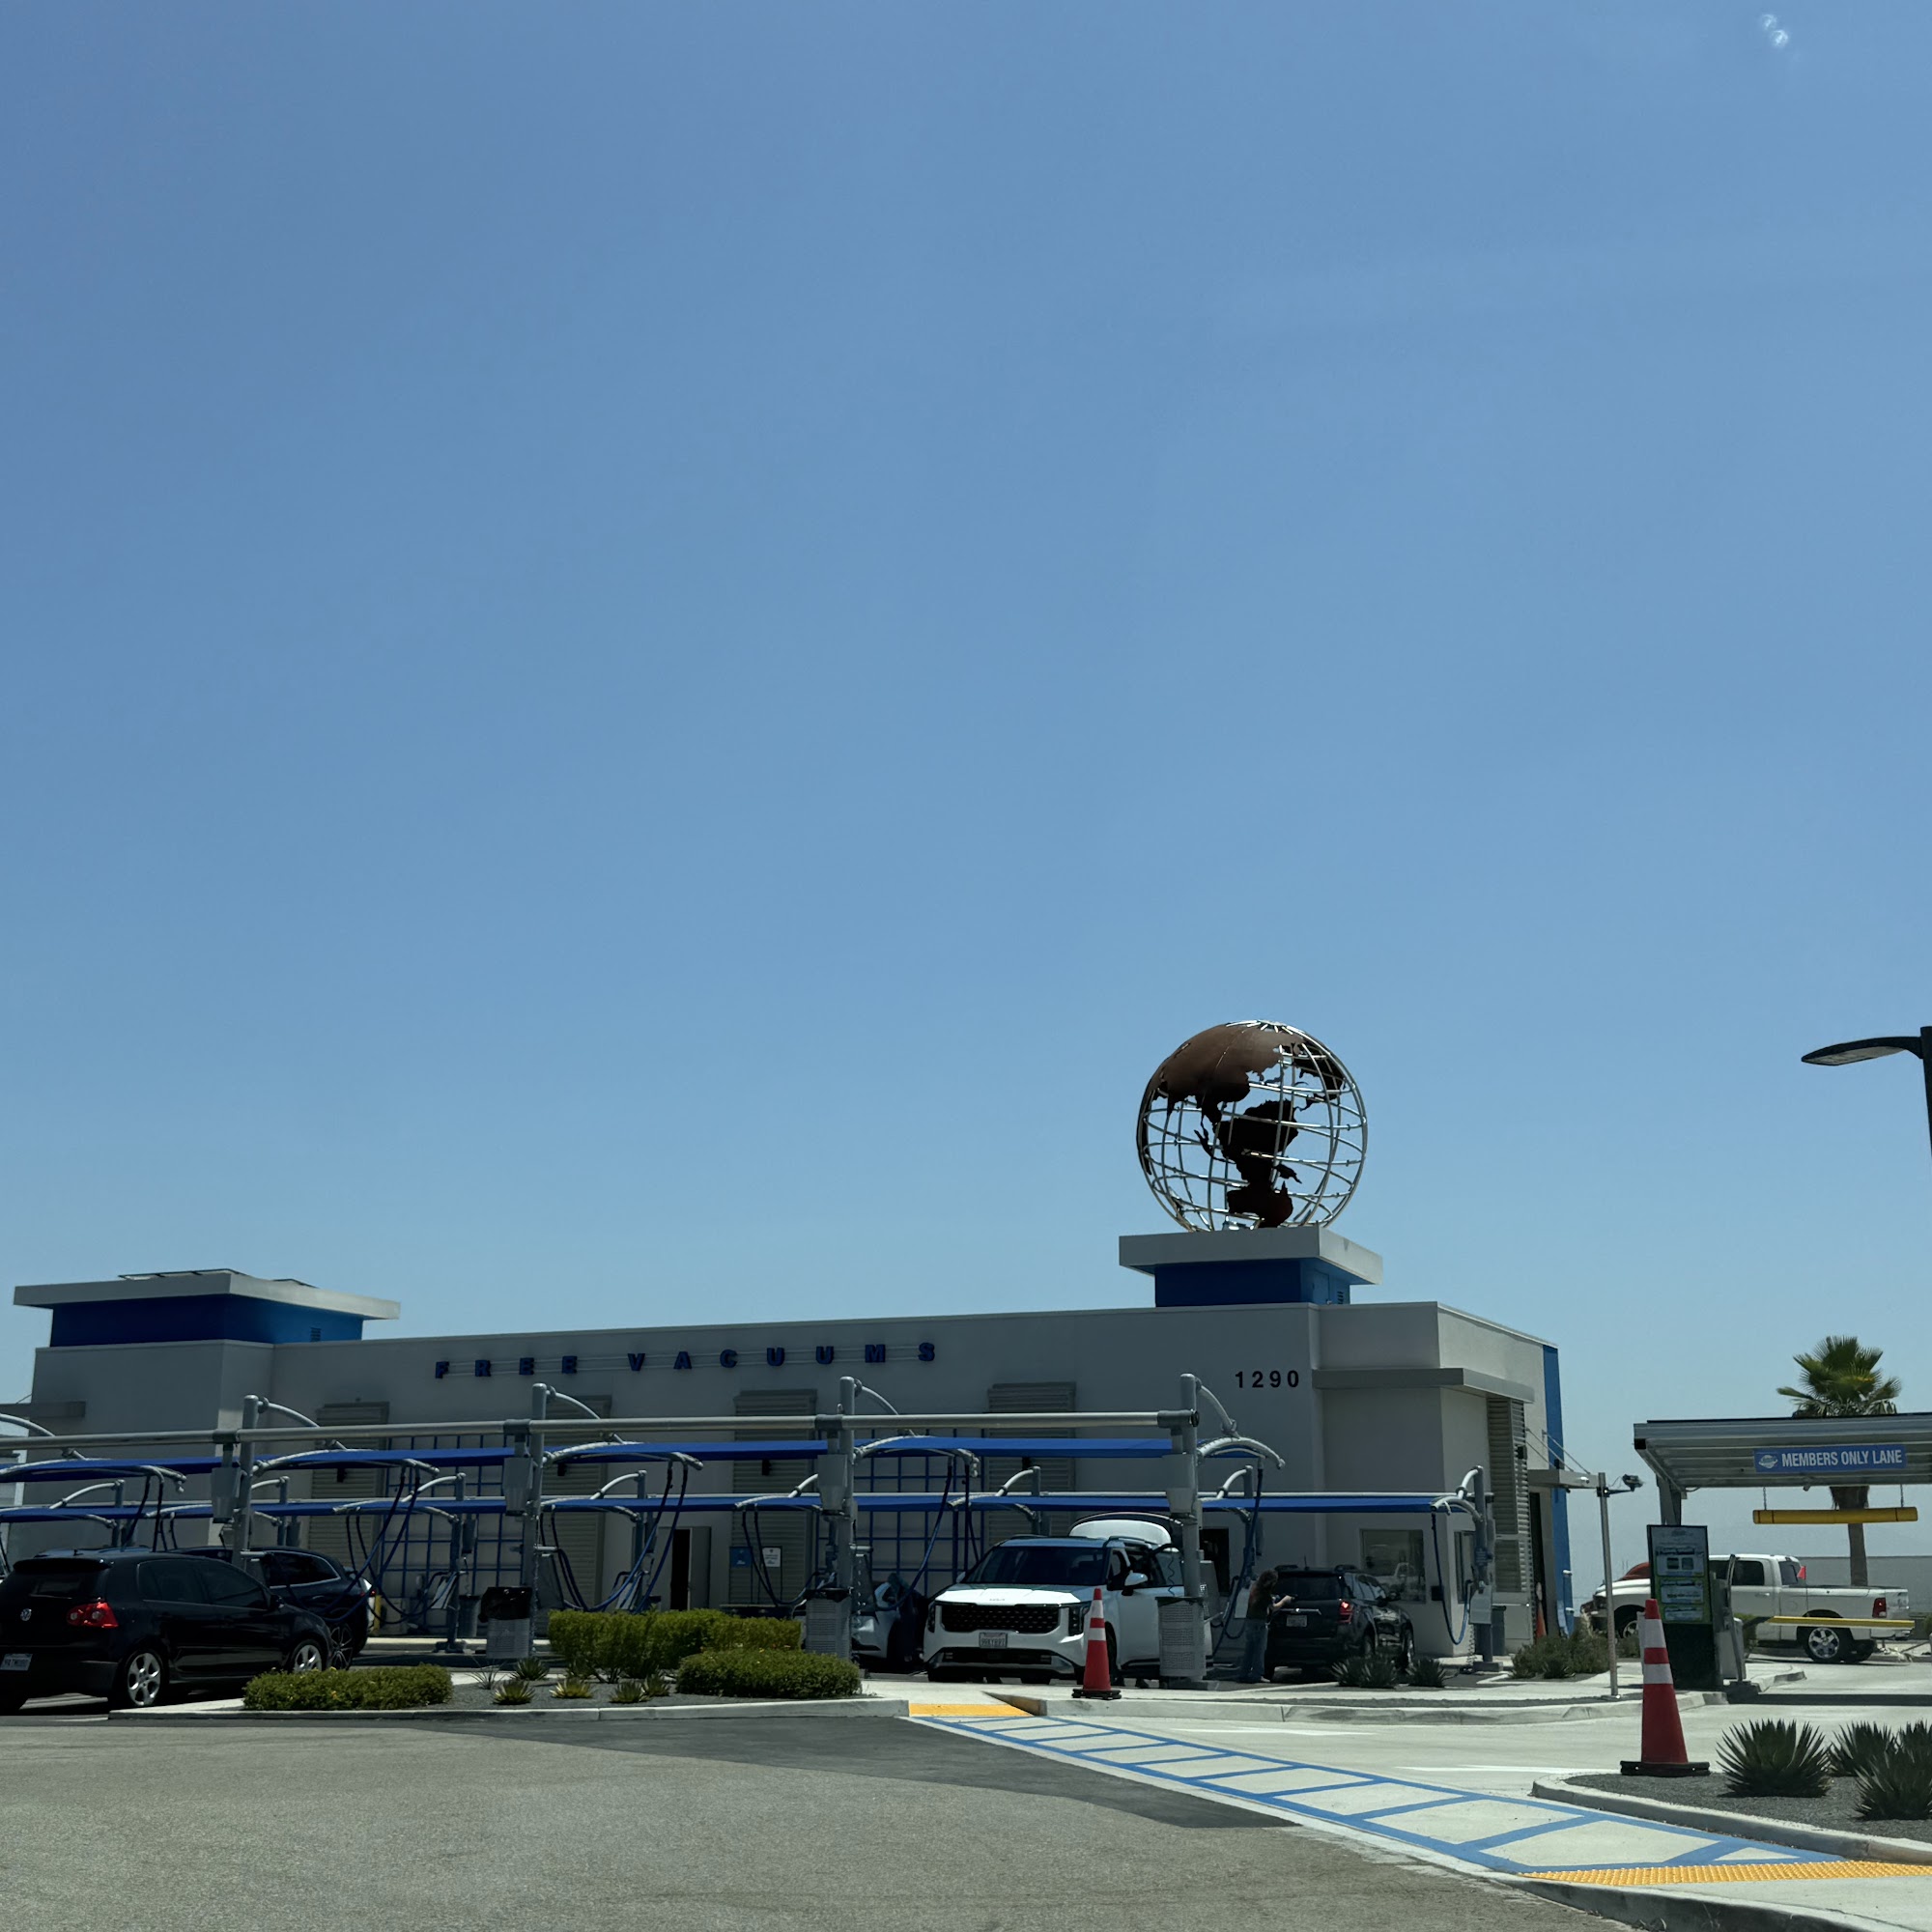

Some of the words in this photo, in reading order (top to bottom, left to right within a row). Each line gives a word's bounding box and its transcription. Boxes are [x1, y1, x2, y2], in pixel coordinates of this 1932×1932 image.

[435, 1355, 578, 1379] FREE
[627, 1343, 936, 1372] VACUUMS
[1235, 1370, 1299, 1388] 1290
[1781, 1452, 1838, 1467] MEMBERS
[1840, 1450, 1869, 1465] ONLY
[1872, 1449, 1903, 1464] LANE
